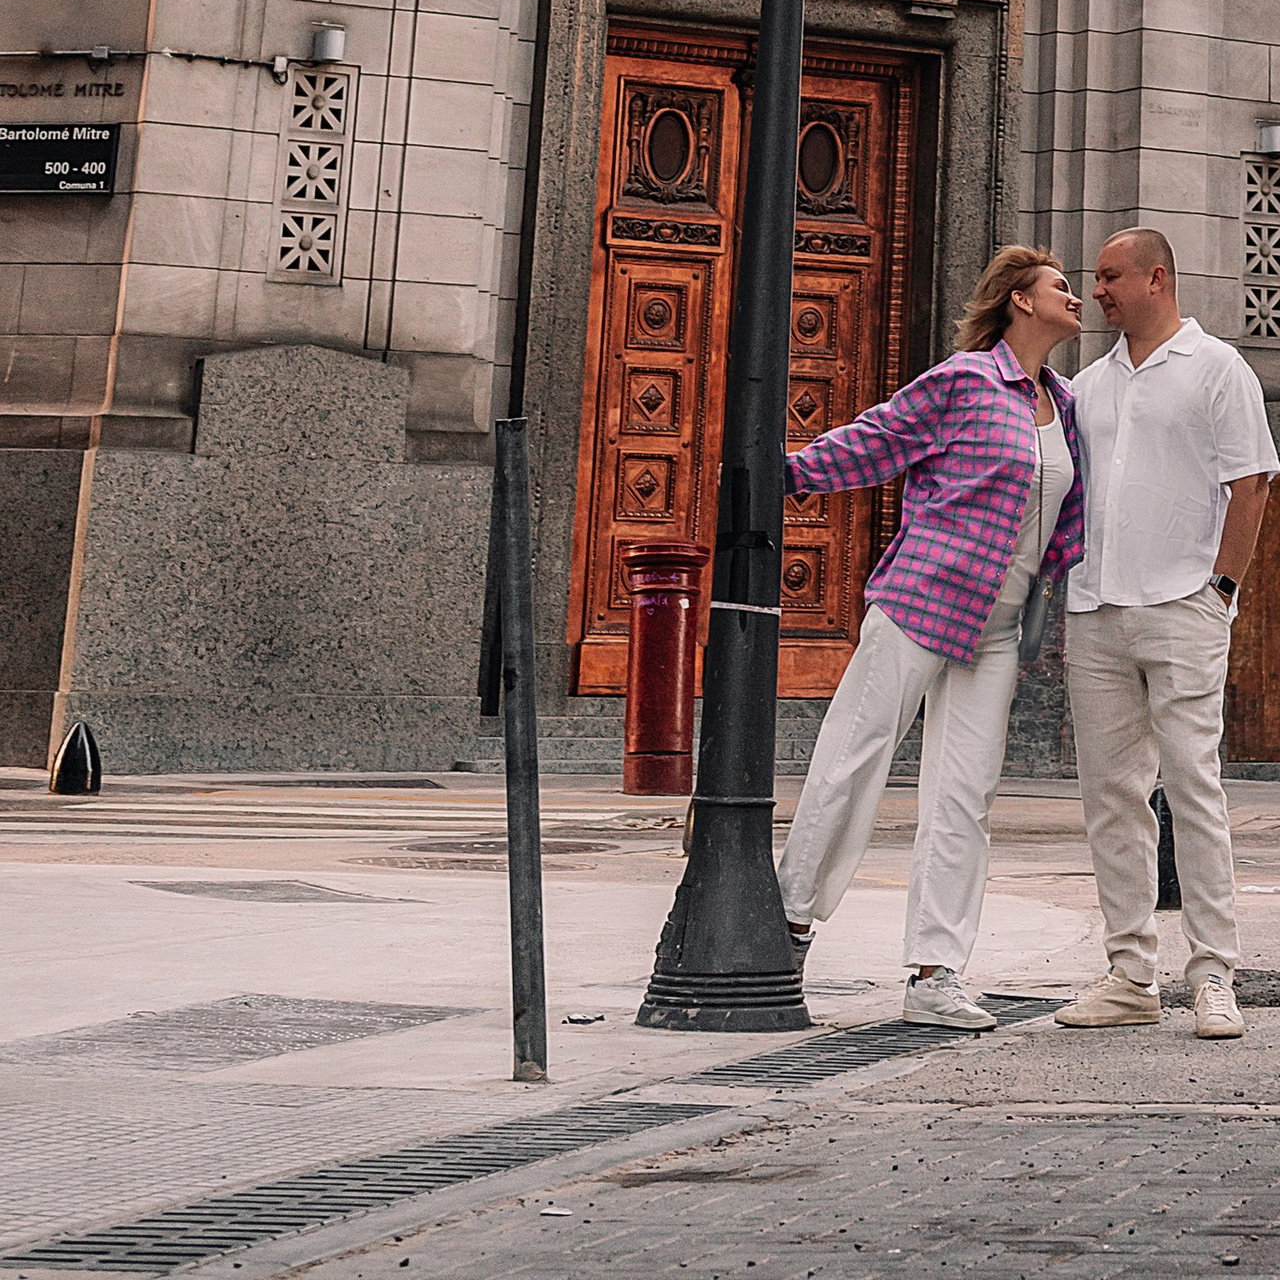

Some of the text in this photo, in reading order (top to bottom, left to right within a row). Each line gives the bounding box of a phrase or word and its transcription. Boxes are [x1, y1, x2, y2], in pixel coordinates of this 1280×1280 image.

[74, 83, 125, 98] MITRE
[0, 127, 110, 140] Bartolomé Mitre
[45, 162, 70, 175] 500
[81, 161, 107, 175] 400
[59, 180, 105, 190] Comuna 1
